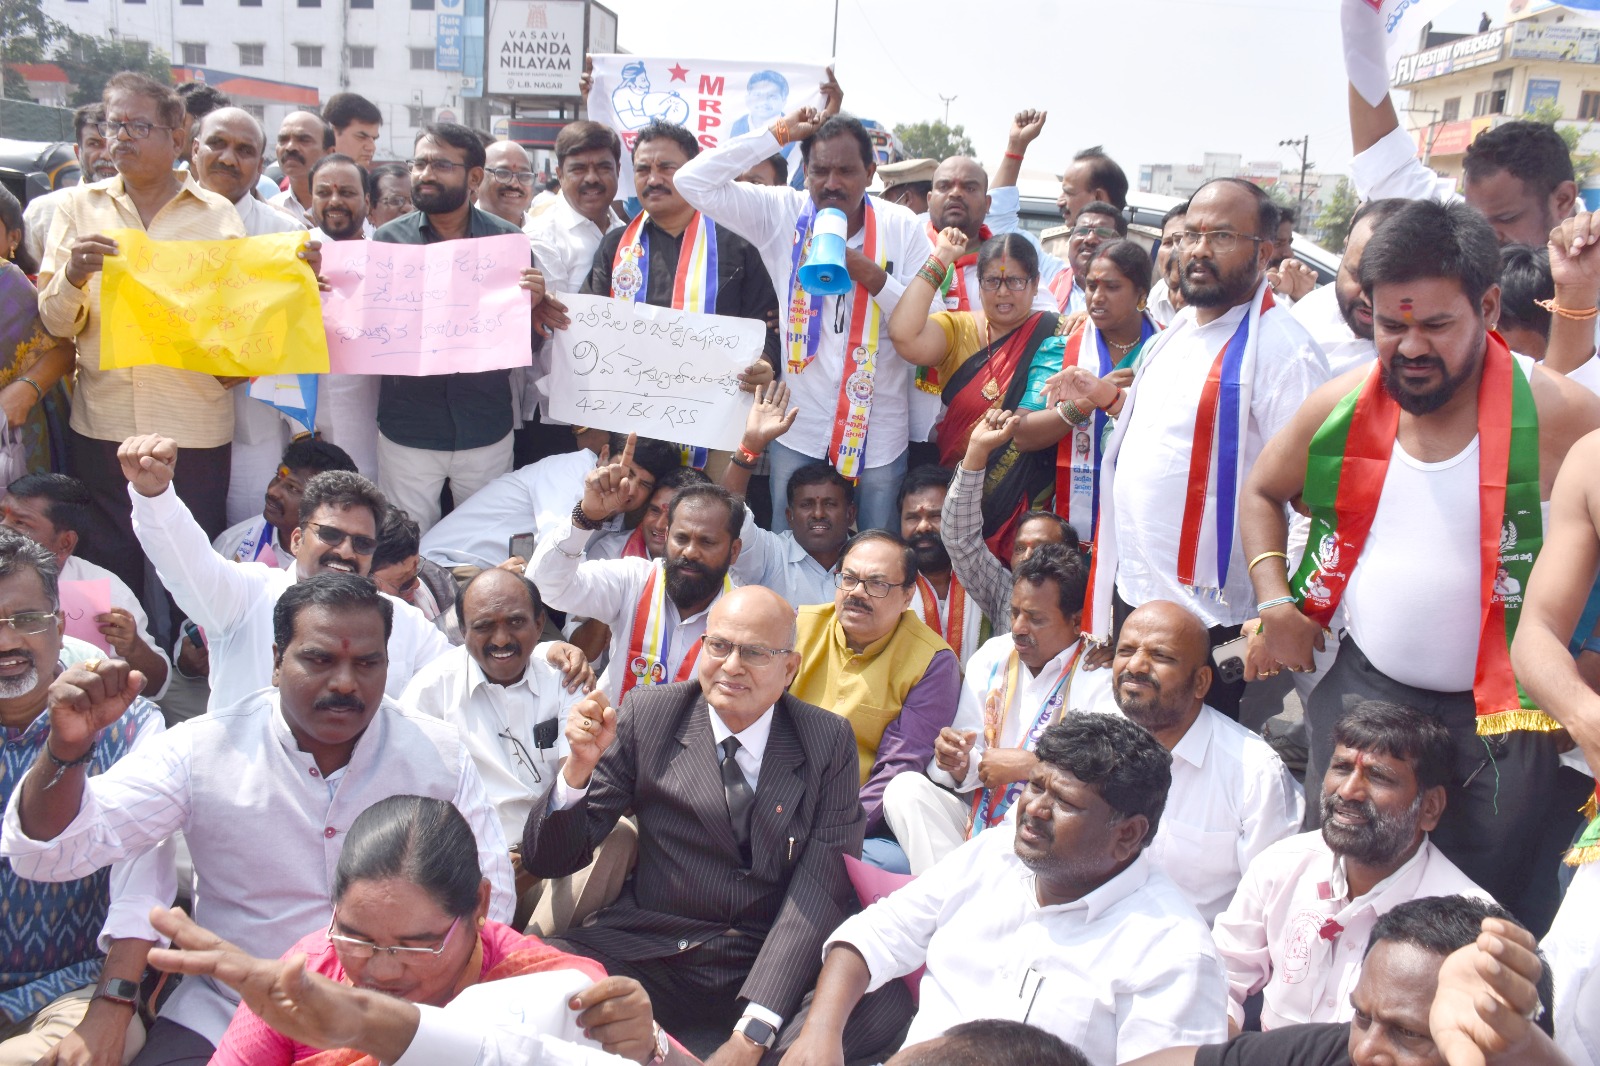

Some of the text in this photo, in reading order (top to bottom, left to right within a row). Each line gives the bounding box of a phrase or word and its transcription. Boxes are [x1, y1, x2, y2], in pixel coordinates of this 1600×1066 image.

[440, 16, 460, 26] State
[440, 26, 460, 36] Bank
[508, 30, 566, 41] VASAVI
[440, 45, 460, 56] India
[500, 41, 572, 56] ANANDA
[499, 55, 572, 71] NILAYAM
[1394, 29, 1504, 86] FLY DESTINY OVERSEAS
[534, 82, 563, 90] NAGAR
[697, 74, 725, 149] MRPS
[187, 246, 241, 275] MBC
[626, 402, 653, 418] BC
[659, 405, 700, 428] RSS
